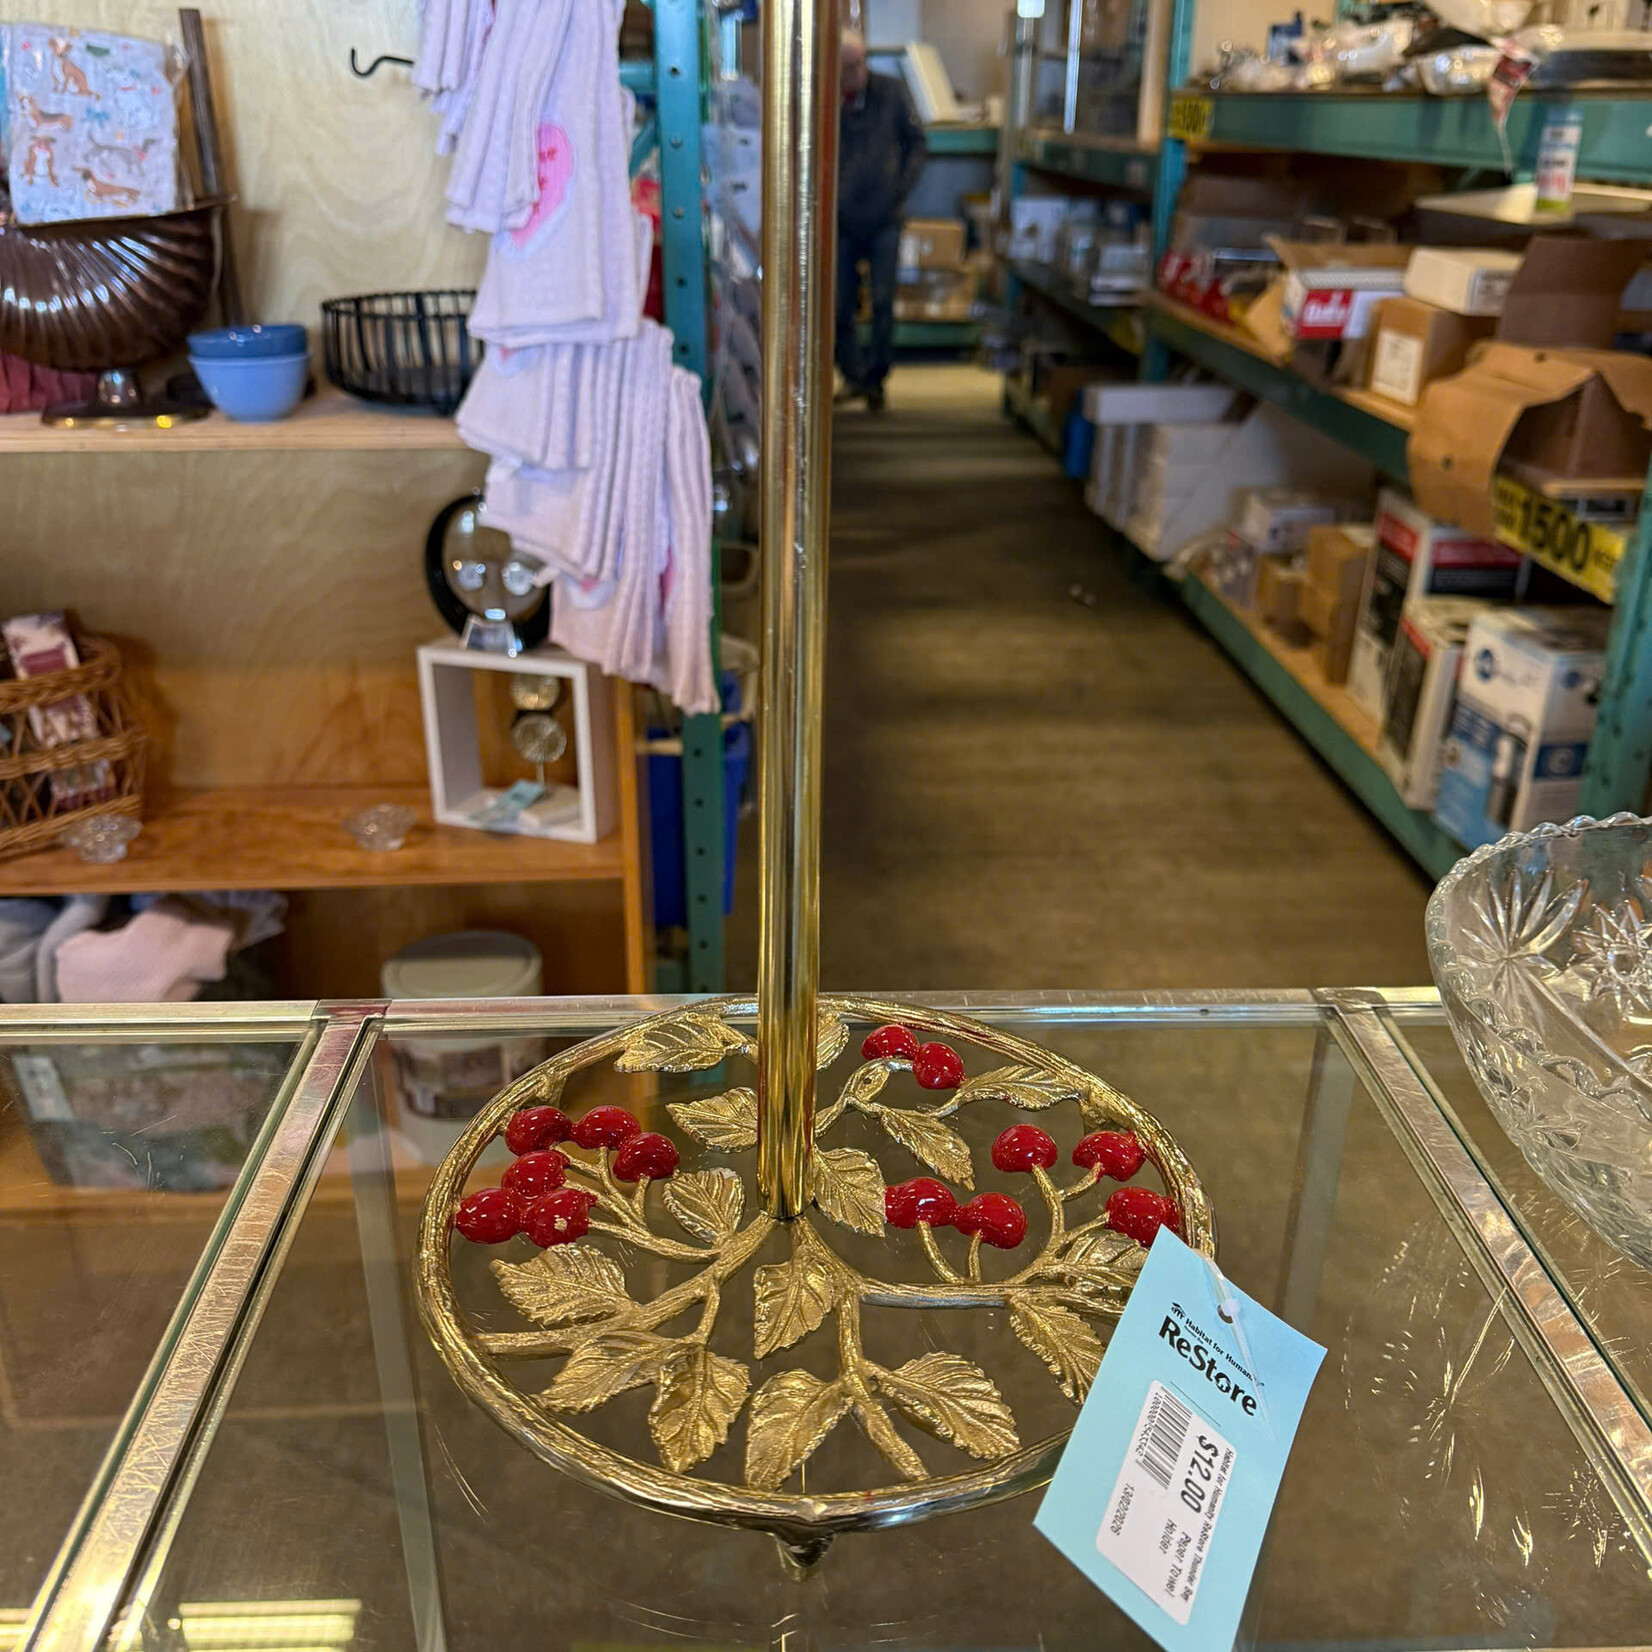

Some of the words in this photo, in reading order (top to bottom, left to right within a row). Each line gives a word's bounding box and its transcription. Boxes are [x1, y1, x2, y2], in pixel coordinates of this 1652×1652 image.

[1519, 498, 1591, 571] 1500
[1185, 1318, 1213, 1346] Habitat
[1213, 1343, 1225, 1356] for
[1158, 1315, 1257, 1417] ReStore
[1181, 1435, 1219, 1513] $12.00
[1219, 1447, 1234, 1475] Habitat
[1216, 1473, 1226, 1486] for
[1110, 1483, 1135, 1536] 13/02/2026
[1204, 1485, 1223, 1521] Humanity
[1159, 1518, 1178, 1555] Holder
[1175, 1531, 1192, 1563] Paper
[1196, 1520, 1212, 1553] ReStore
[1165, 1564, 1183, 1598] Towel
[1186, 1553, 1203, 1586] Thunder
[1180, 1586, 1193, 1602] Bay
